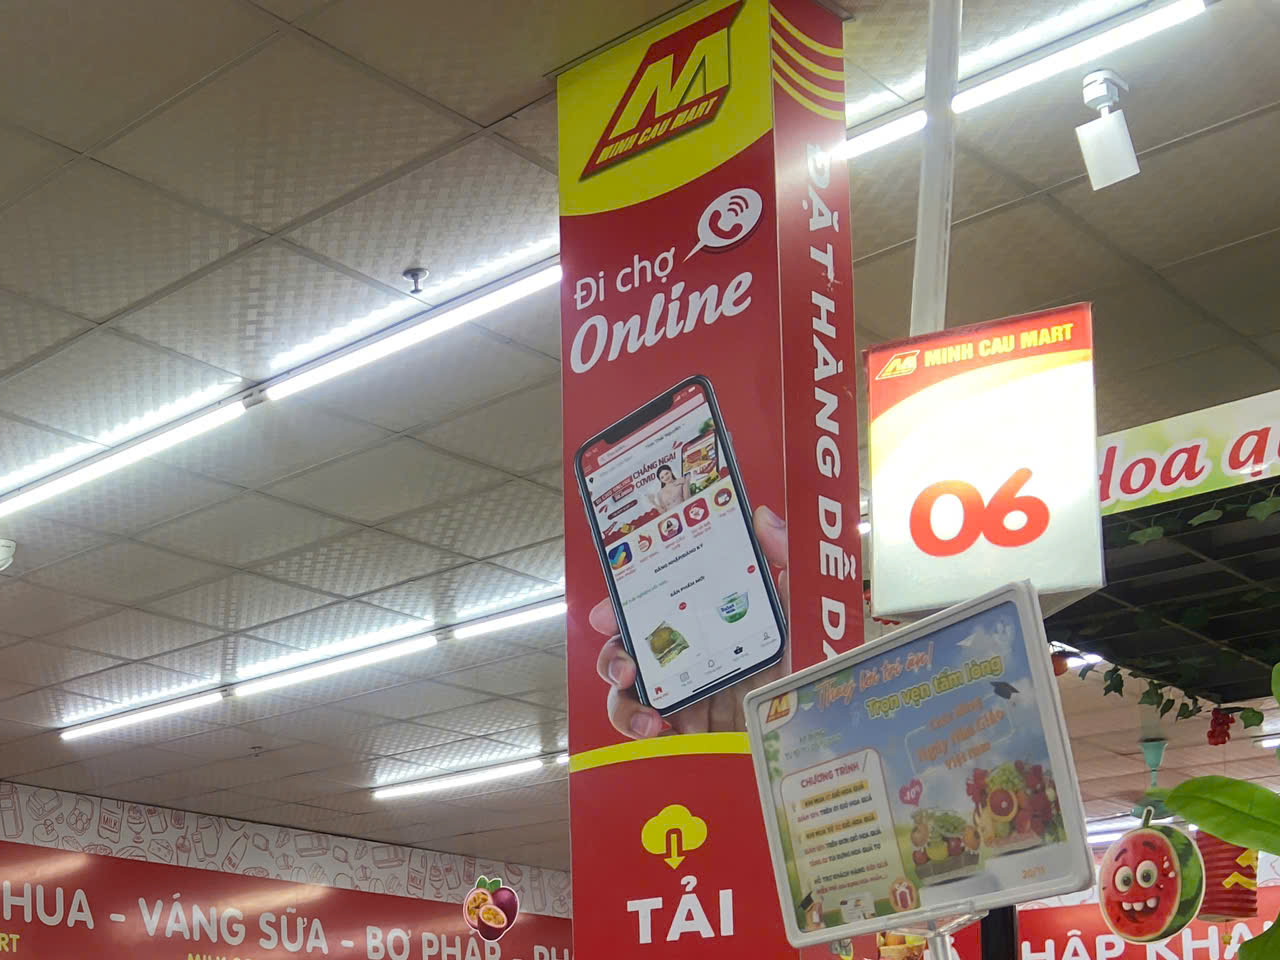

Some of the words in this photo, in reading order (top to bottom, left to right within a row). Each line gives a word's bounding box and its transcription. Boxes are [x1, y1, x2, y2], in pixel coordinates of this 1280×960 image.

[595, 132, 640, 165] MINH
[637, 116, 673, 145] CAU
[669, 96, 719, 131] MART
[573, 271, 606, 311] Đi
[615, 246, 676, 293] chợ
[569, 271, 754, 375] Online
[923, 342, 975, 368] MINH
[978, 334, 1016, 358] CAU
[1019, 322, 1075, 350] MART
[811, 290, 843, 479] HÀNG
[817, 495, 857, 581] DỄ
[909, 466, 1051, 558] 06
[138, 893, 247, 947] VÁNG
[259, 906, 329, 956] SỮA
[626, 875, 735, 946] TẢI
